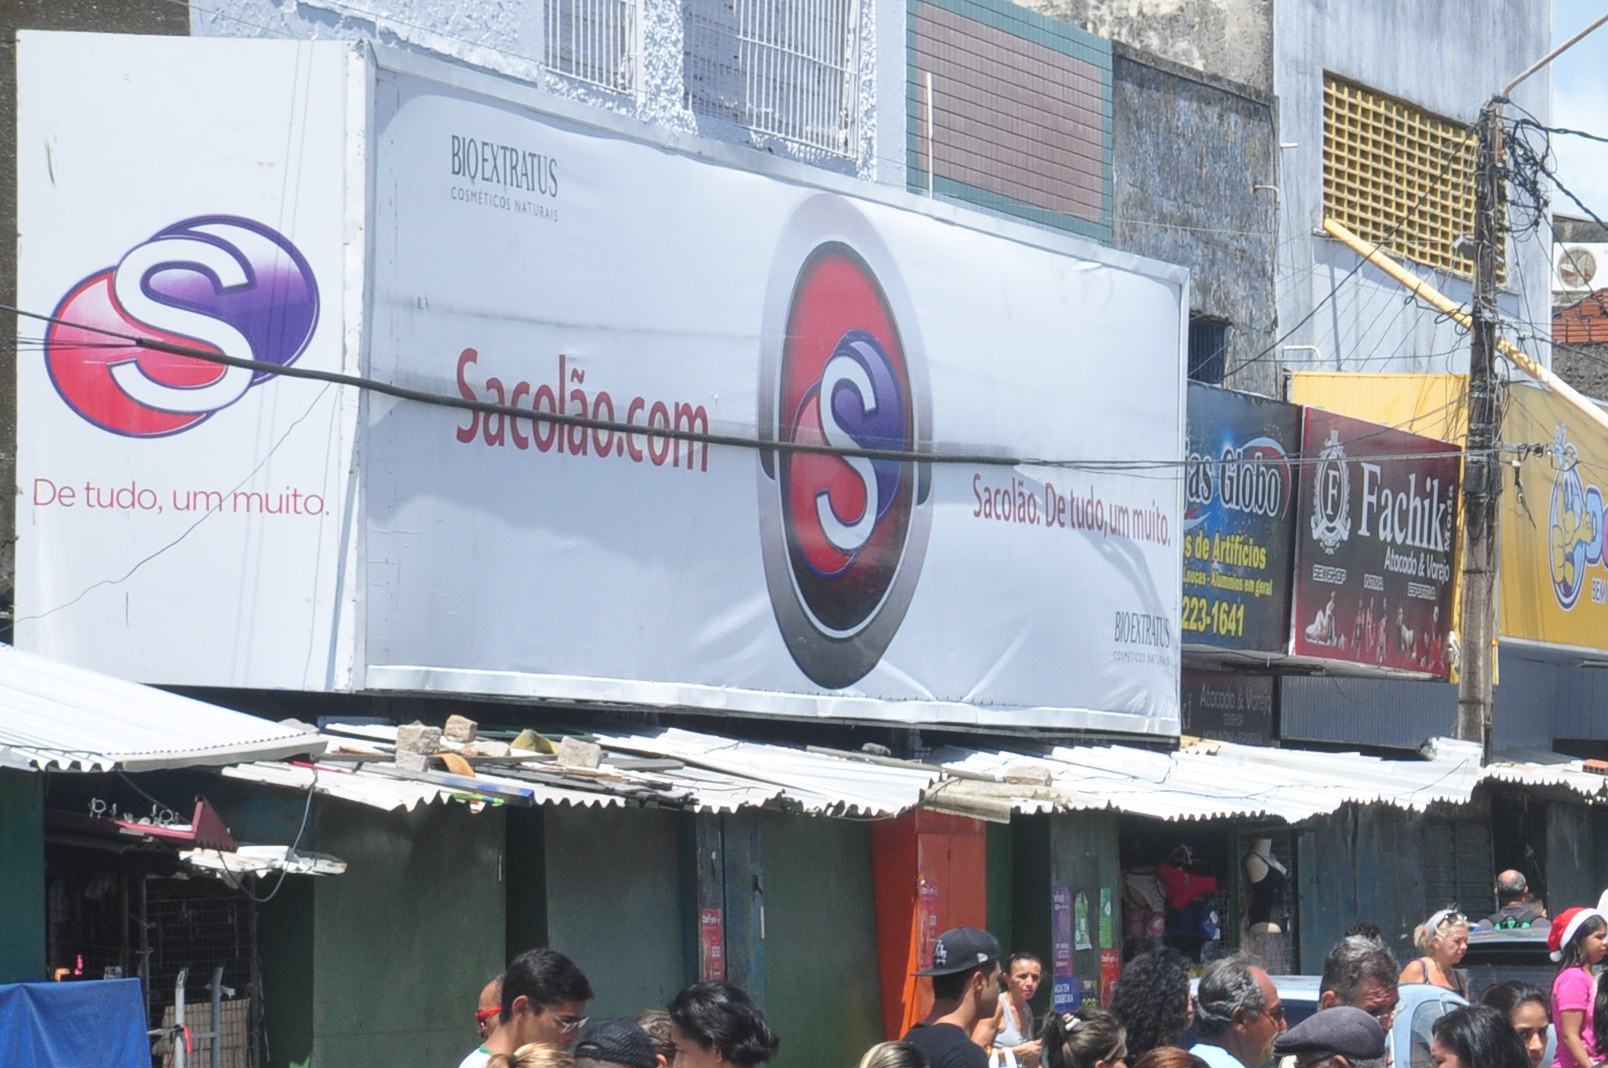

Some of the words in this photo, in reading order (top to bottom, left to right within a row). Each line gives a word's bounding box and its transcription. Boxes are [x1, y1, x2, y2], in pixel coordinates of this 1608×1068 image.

[514, 200, 558, 223] NATURAIS
[456, 347, 710, 473] Sacolão.com
[32, 478, 74, 508] De
[83, 478, 164, 515] tudo,
[172, 488, 223, 512] um
[232, 486, 331, 517] muito.
[1219, 447, 1281, 518] Globo
[973, 472, 1041, 526] Sacolão.
[1045, 482, 1066, 529] De
[1070, 484, 1108, 538] tudo,
[1109, 503, 1130, 539] um
[1133, 500, 1171, 547] muito.
[1357, 461, 1447, 552] Fachik
[1195, 529, 1210, 560] de
[1212, 532, 1267, 571] Artifícios
[1417, 552, 1427, 577] &
[1255, 578, 1273, 599] geral
